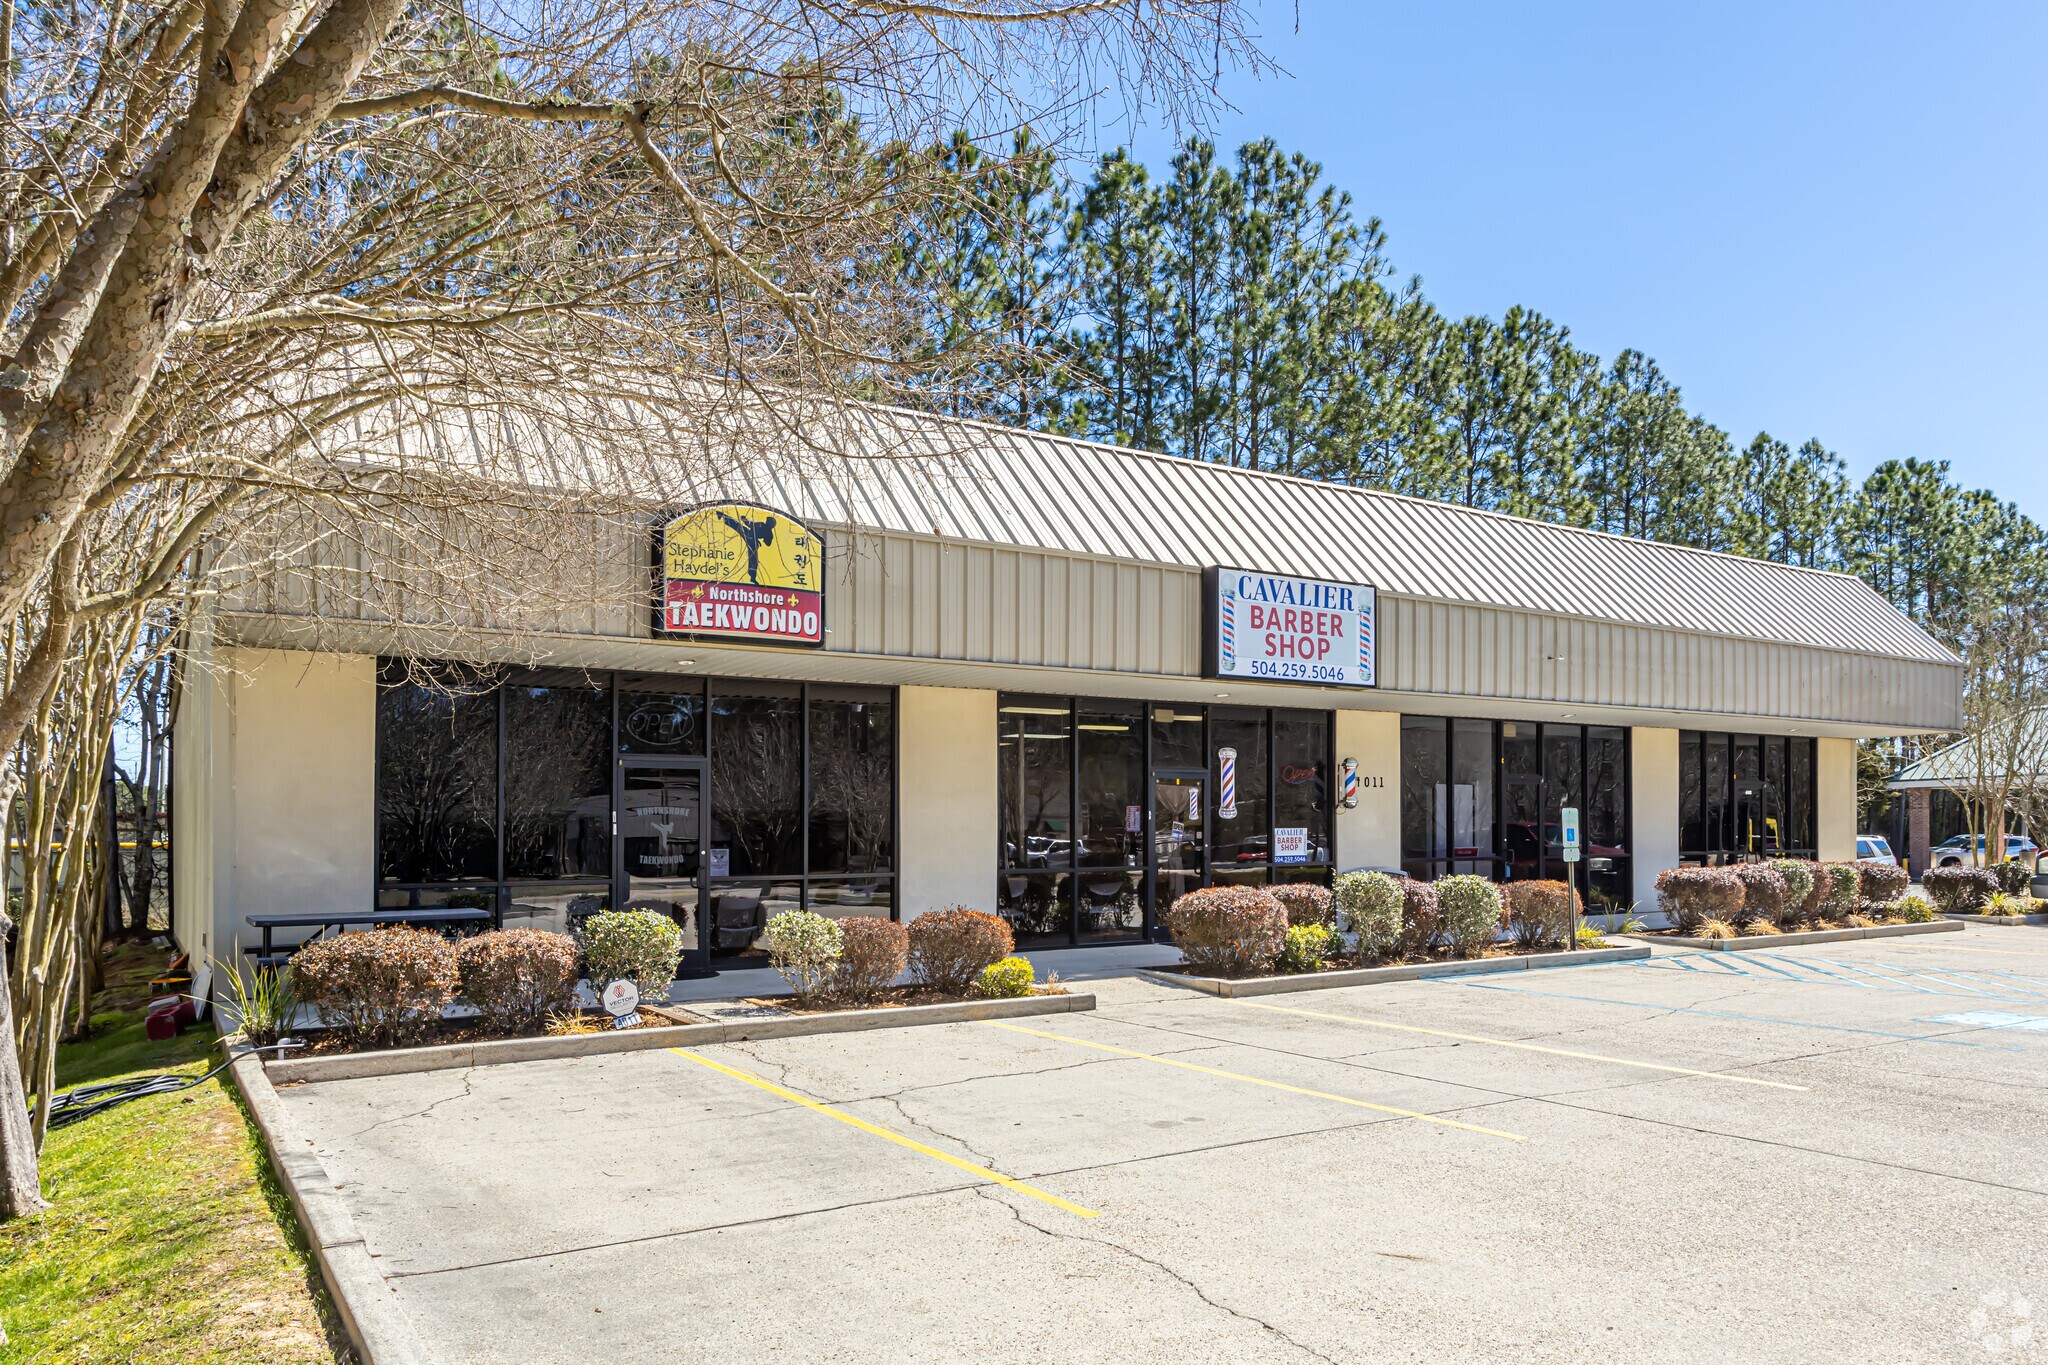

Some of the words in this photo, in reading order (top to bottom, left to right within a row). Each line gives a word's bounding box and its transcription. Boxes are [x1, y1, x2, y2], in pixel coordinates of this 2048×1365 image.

[669, 542, 735, 563] Stephanie
[674, 559, 730, 576] Haydel's
[709, 587, 784, 606] Northshore
[1238, 575, 1354, 611] CAVALIER
[669, 601, 818, 636] TAEKWONDO
[1250, 605, 1344, 637] BARBER
[1265, 632, 1331, 661] SHOP
[1251, 660, 1344, 681] 504.259.5046
[631, 712, 688, 736] OPEN
[1282, 764, 1316, 783] Open
[636, 806, 690, 817] NORTHSHORE
[639, 855, 684, 865] TAEKWONDO
[609, 996, 634, 1006] VECTOR
